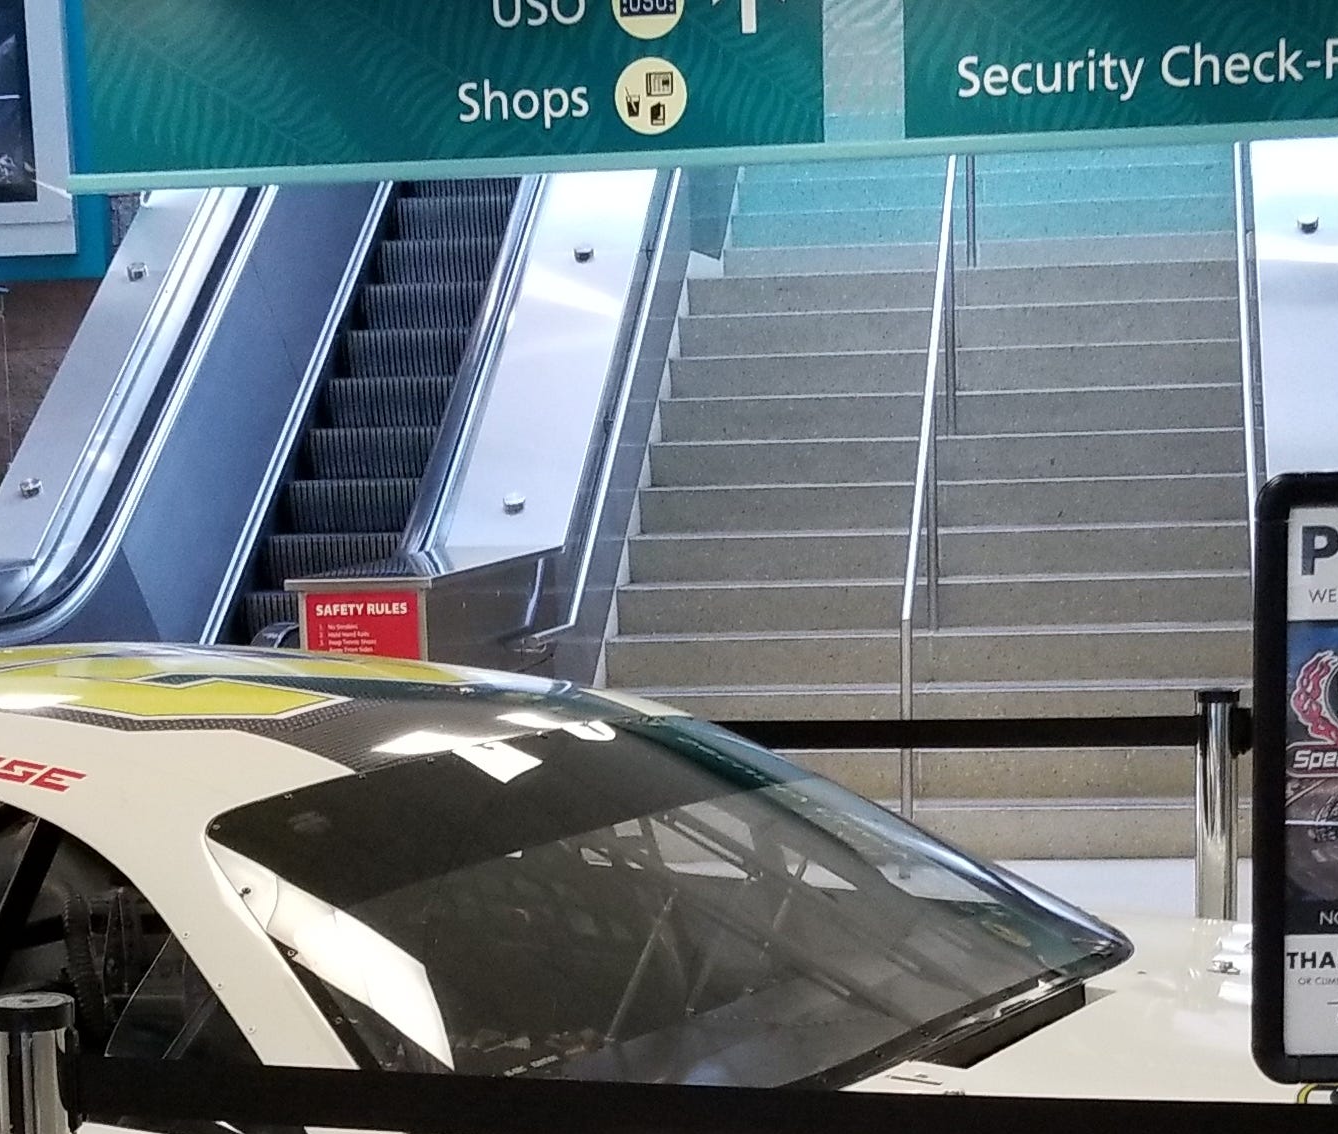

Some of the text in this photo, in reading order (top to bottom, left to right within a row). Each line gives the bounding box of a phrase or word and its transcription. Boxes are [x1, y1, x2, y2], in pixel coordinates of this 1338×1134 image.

[493, 0, 586, 28] USO
[957, 48, 1146, 101] Security
[457, 79, 590, 129] Shops
[315, 602, 408, 616] SAFETY RULES
